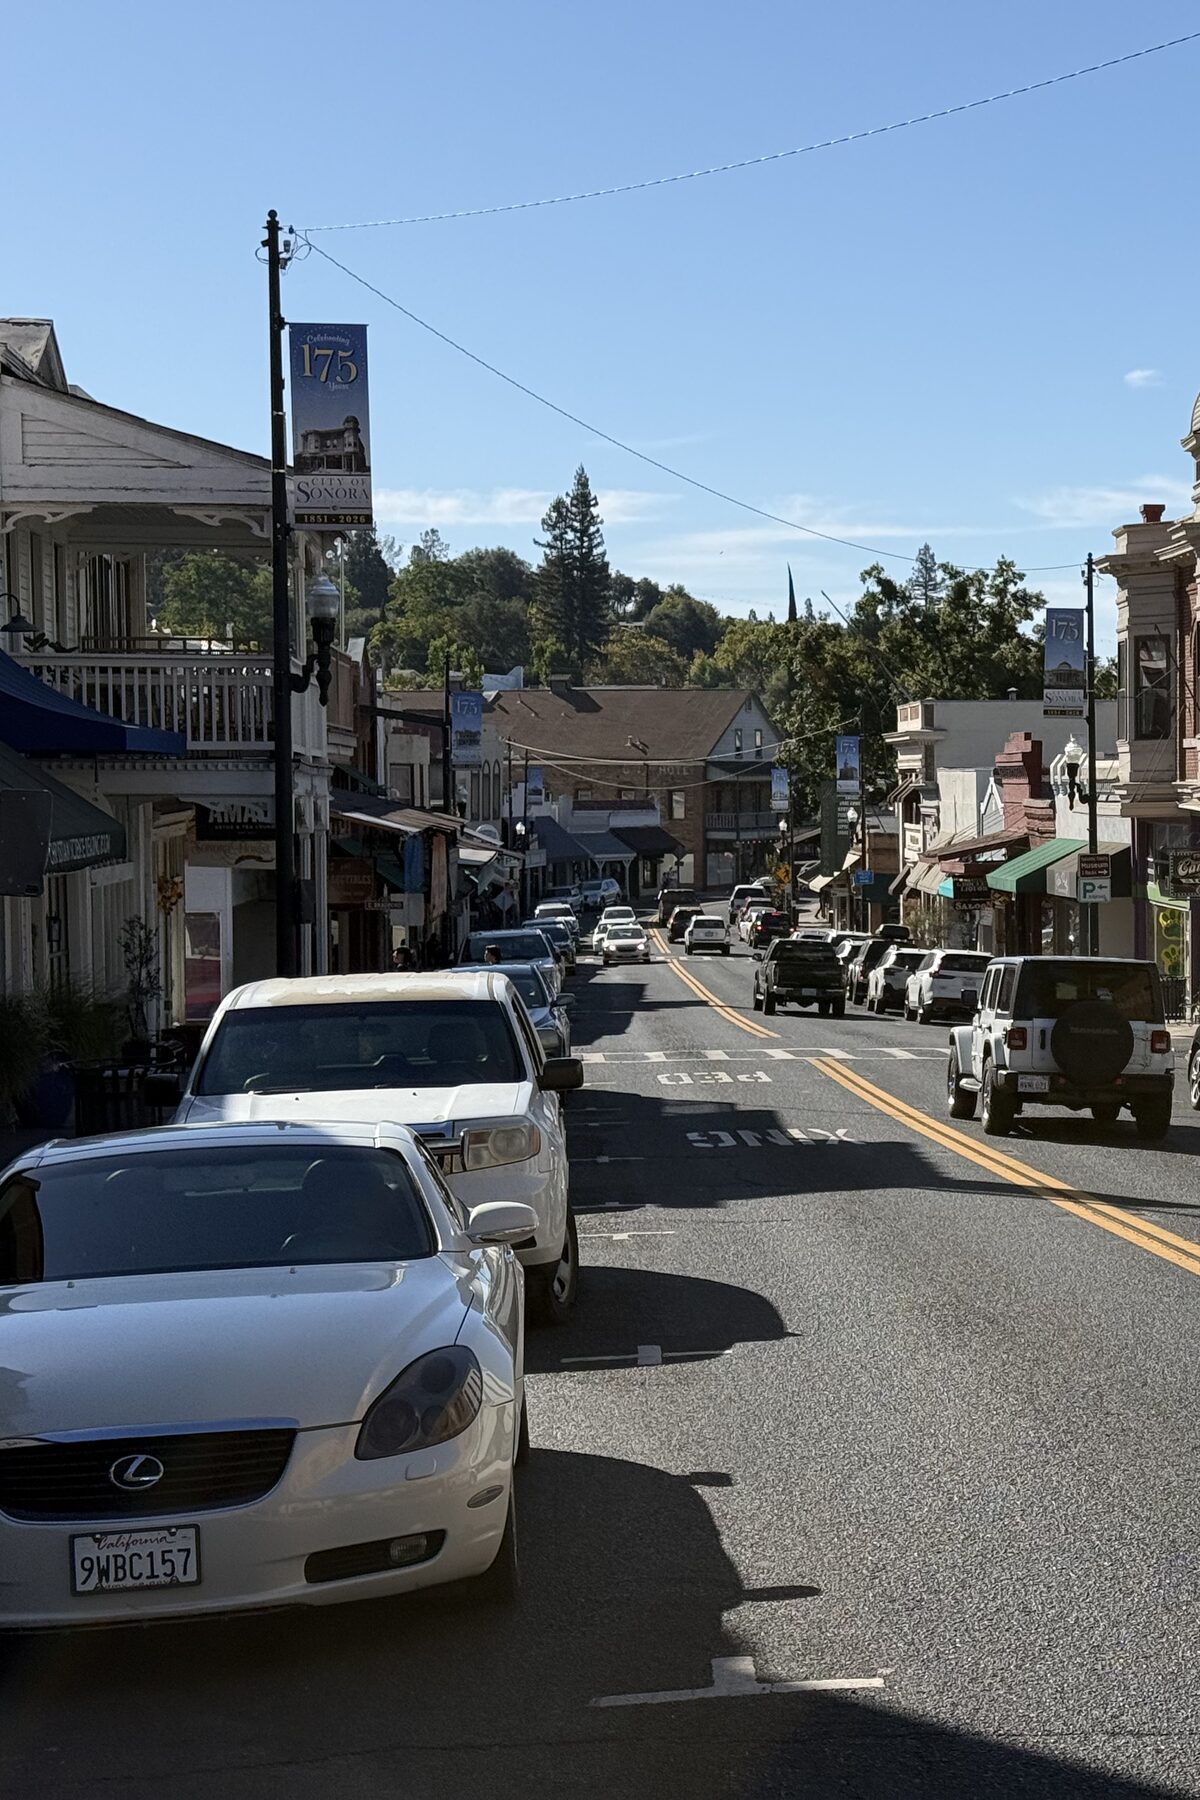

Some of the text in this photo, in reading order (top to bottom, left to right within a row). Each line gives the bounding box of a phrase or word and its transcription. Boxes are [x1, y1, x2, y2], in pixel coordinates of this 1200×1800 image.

[301, 344, 358, 384] 175
[311, 477, 344, 486] CITY
[296, 480, 370, 504] SONORA
[303, 514, 329, 523] 1851
[338, 515, 366, 523] 2026
[1051, 618, 1080, 641] 175
[456, 699, 478, 715] 175
[97, 1534, 168, 1552] California
[80, 1547, 191, 1586] 9WBC157
